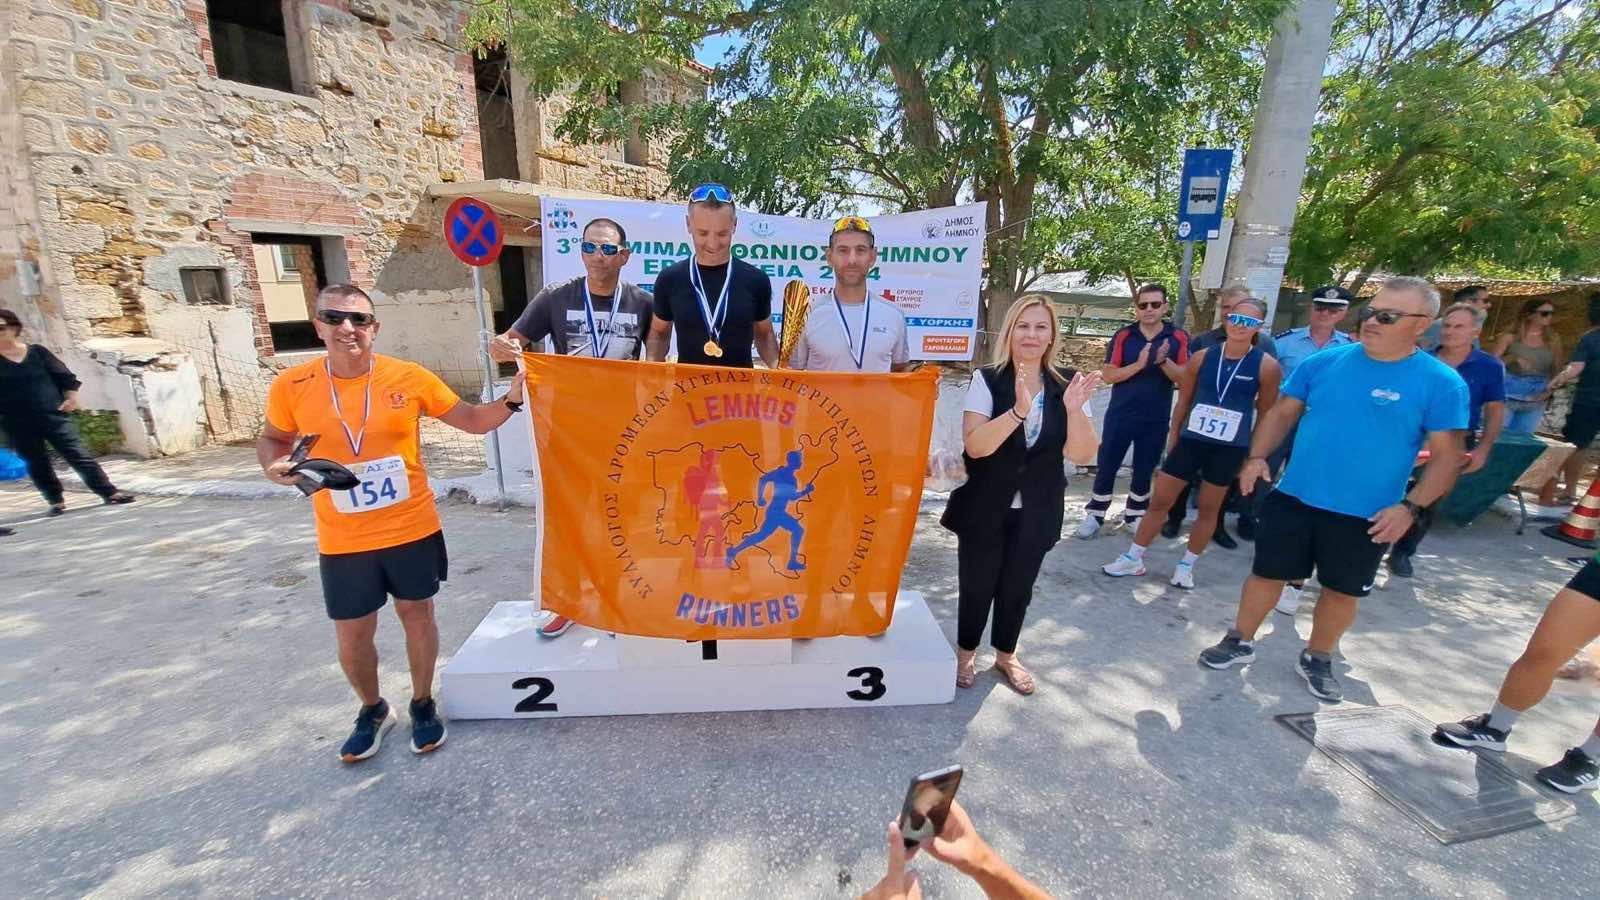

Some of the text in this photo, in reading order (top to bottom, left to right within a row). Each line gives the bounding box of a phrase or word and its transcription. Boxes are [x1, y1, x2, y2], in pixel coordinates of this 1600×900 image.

[944, 216, 974, 228] ΔΗΜΟΣ
[944, 228, 980, 238] ΛΗΜΝΟΥ
[875, 246, 969, 263] ΗΜΝΟΥ
[673, 371, 750, 395] ΥΓΕΙΑΣ
[760, 372, 771, 385] &
[686, 392, 798, 427] LEMNOS
[1199, 416, 1229, 437] 151
[607, 390, 671, 484] ΔΡΟΜΕΩΝ
[782, 377, 880, 498] ΠΕΡΙΠΑΤΗΤΩΝ
[604, 492, 654, 599] ΣΥΛΛΟΓΟΣ
[676, 592, 800, 628] RUNNERS
[511, 676, 558, 713] 2
[846, 666, 887, 701] 3
